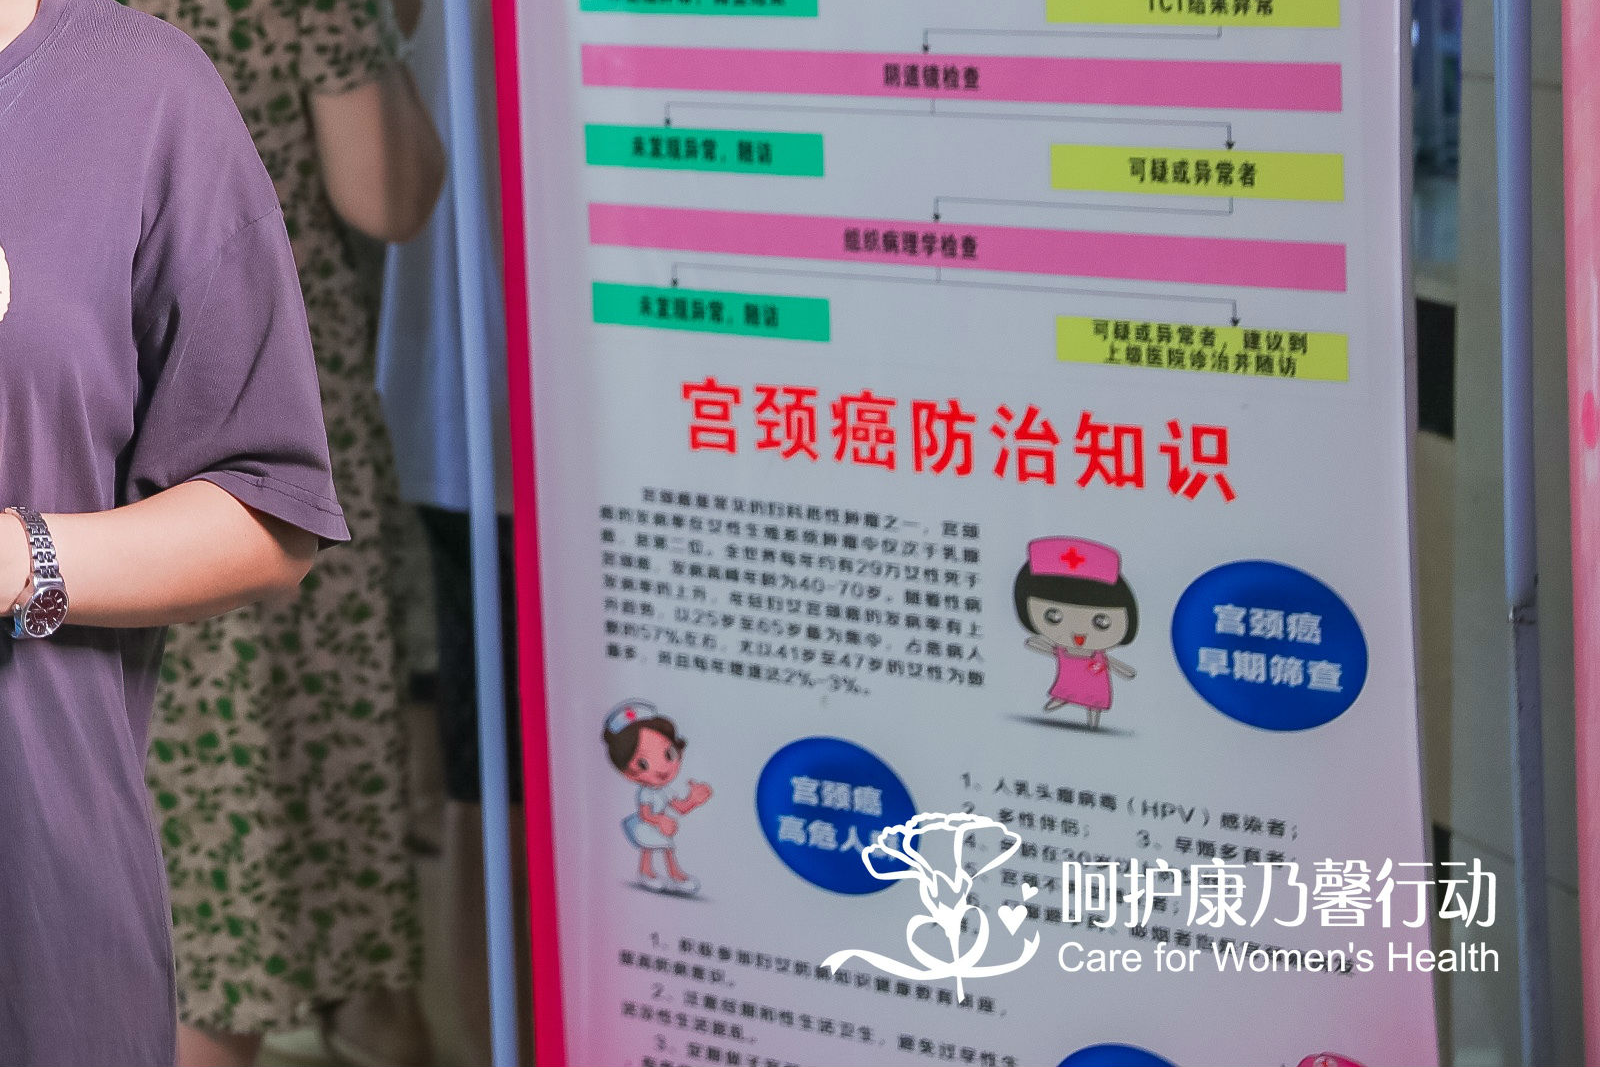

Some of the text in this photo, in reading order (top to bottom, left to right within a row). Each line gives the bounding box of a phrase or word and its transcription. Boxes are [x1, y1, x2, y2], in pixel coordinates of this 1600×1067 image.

[883, 62, 981, 92] 阴道镜检查
[1128, 155, 1257, 189] 可疑或异常者
[843, 227, 979, 261] 组织病理学检查
[1092, 318, 1309, 355] 可疑或异常者，建议到
[1104, 340, 1298, 379] 上级医院诊治并随访
[680, 377, 1234, 502] 宫颈癌防治知识
[1212, 603, 1323, 645] 宫颈癌
[1196, 646, 1344, 692] 早期筛查
[789, 775, 884, 818] 宫颈癌
